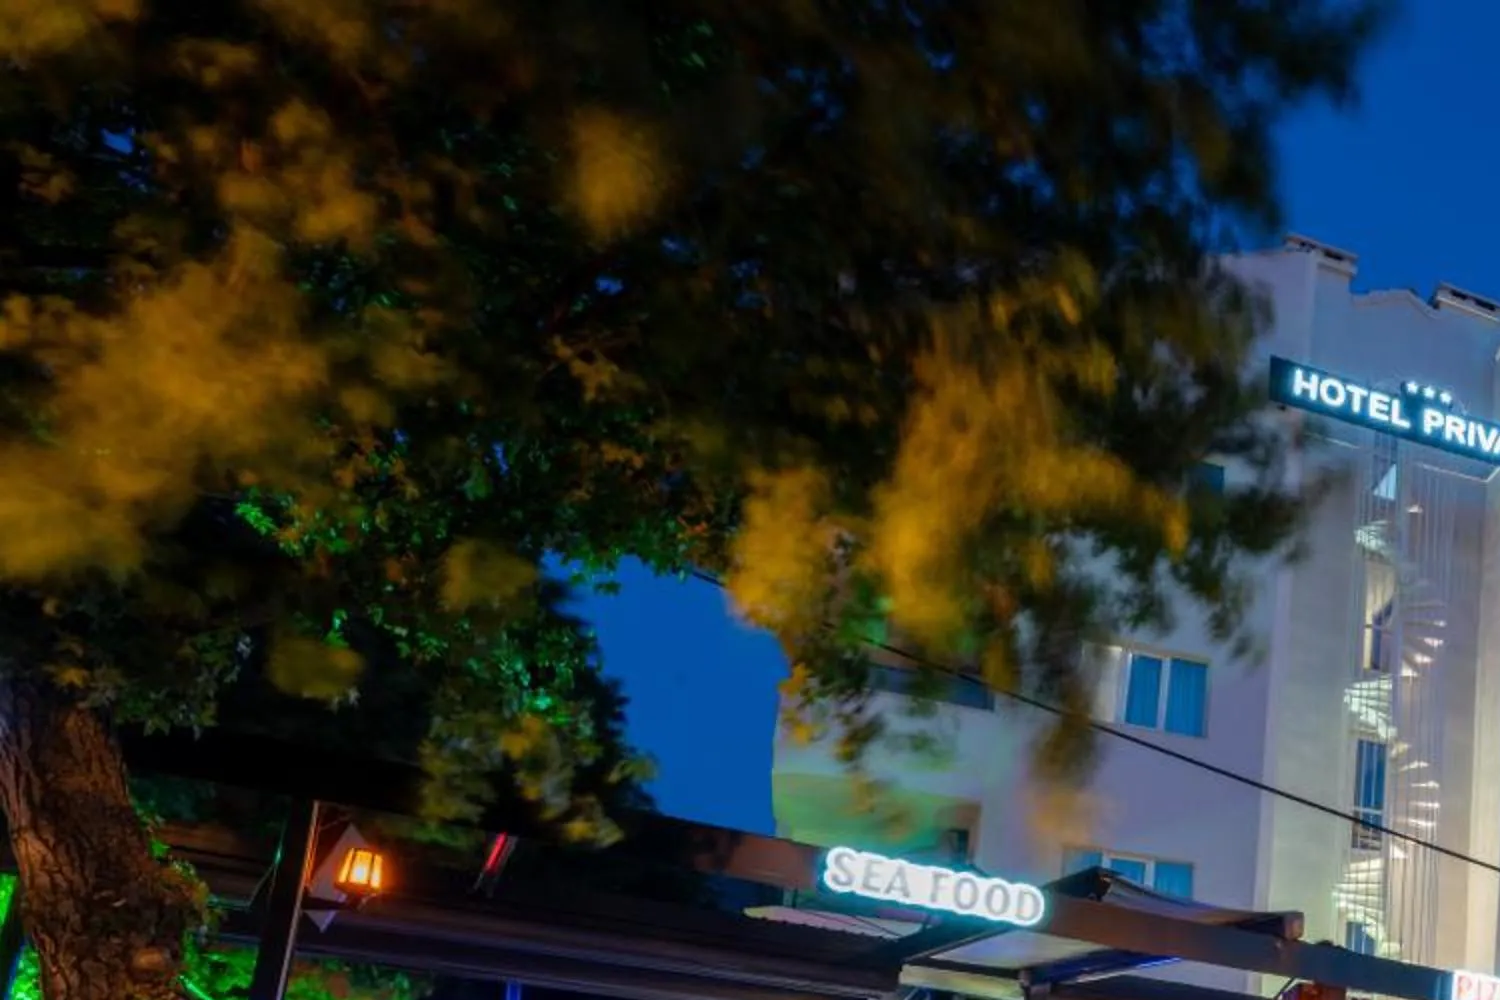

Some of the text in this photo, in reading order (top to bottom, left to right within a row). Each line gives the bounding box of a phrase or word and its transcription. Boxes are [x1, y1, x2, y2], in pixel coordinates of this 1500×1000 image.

[1292, 368, 1411, 429] HOTEL
[829, 849, 1043, 923] SEA FOOD
